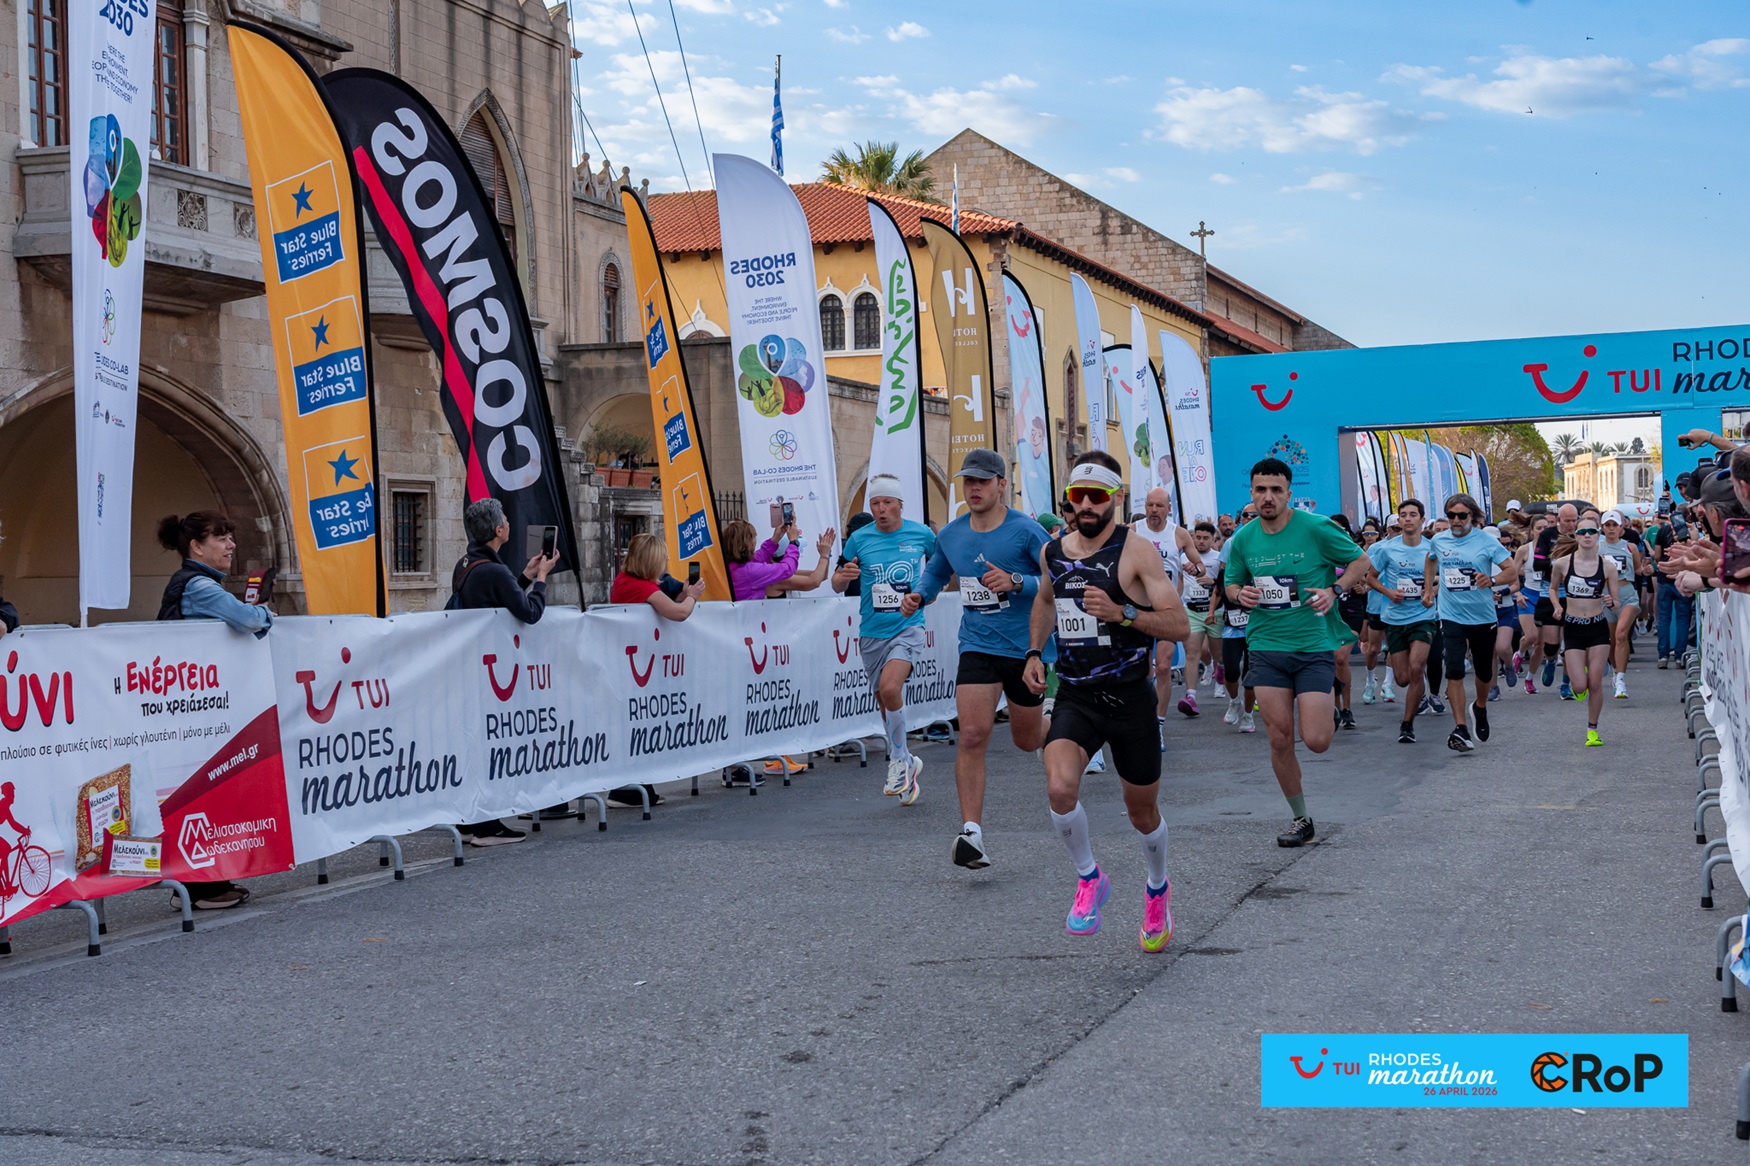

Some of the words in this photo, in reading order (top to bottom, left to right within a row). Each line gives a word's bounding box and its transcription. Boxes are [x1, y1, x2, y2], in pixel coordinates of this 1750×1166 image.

[1607, 368, 1661, 394] TUI
[869, 560, 914, 585] 10
[1449, 577, 1466, 585] 1225
[878, 595, 899, 604] 1256
[966, 591, 991, 601] 1238
[1261, 589, 1283, 600] 1050
[1571, 585, 1589, 594] 1369
[1060, 617, 1086, 632] 1001
[1233, 615, 1248, 623] 1237
[1572, 617, 1591, 625] PRO
[662, 653, 684, 678] TUI
[772, 644, 790, 666] TUI
[527, 663, 551, 690] TUI
[910, 659, 937, 679] ODES
[351, 678, 390, 710] TUI
[746, 678, 791, 704] RHODES
[905, 668, 957, 706] maratho
[141, 702, 163, 717] που
[166, 691, 229, 716] χρειάζεσαι!
[629, 691, 687, 721] RHODES
[745, 689, 820, 737] marathon
[832, 684, 880, 720] marath
[486, 706, 558, 741] RHODES
[630, 703, 729, 757] marathon
[0, 745, 36, 760] πλούσιο
[39, 745, 52, 756] σε
[54, 738, 89, 757] φυτικές
[90, 737, 108, 750] ίνες
[113, 732, 139, 749] χωρίς
[140, 729, 177, 746] γλουτένη
[182, 726, 202, 741] μόνο
[203, 728, 213, 739] με
[214, 722, 231, 738] μέλι
[299, 727, 394, 769] RHODES
[488, 719, 610, 781] marathon
[207, 743, 259, 781] www.mel.gr
[301, 740, 463, 816] marathon
[185, 817, 277, 845] Μελισσοκομικη
[191, 835, 265, 860] Δωδεκανησου
